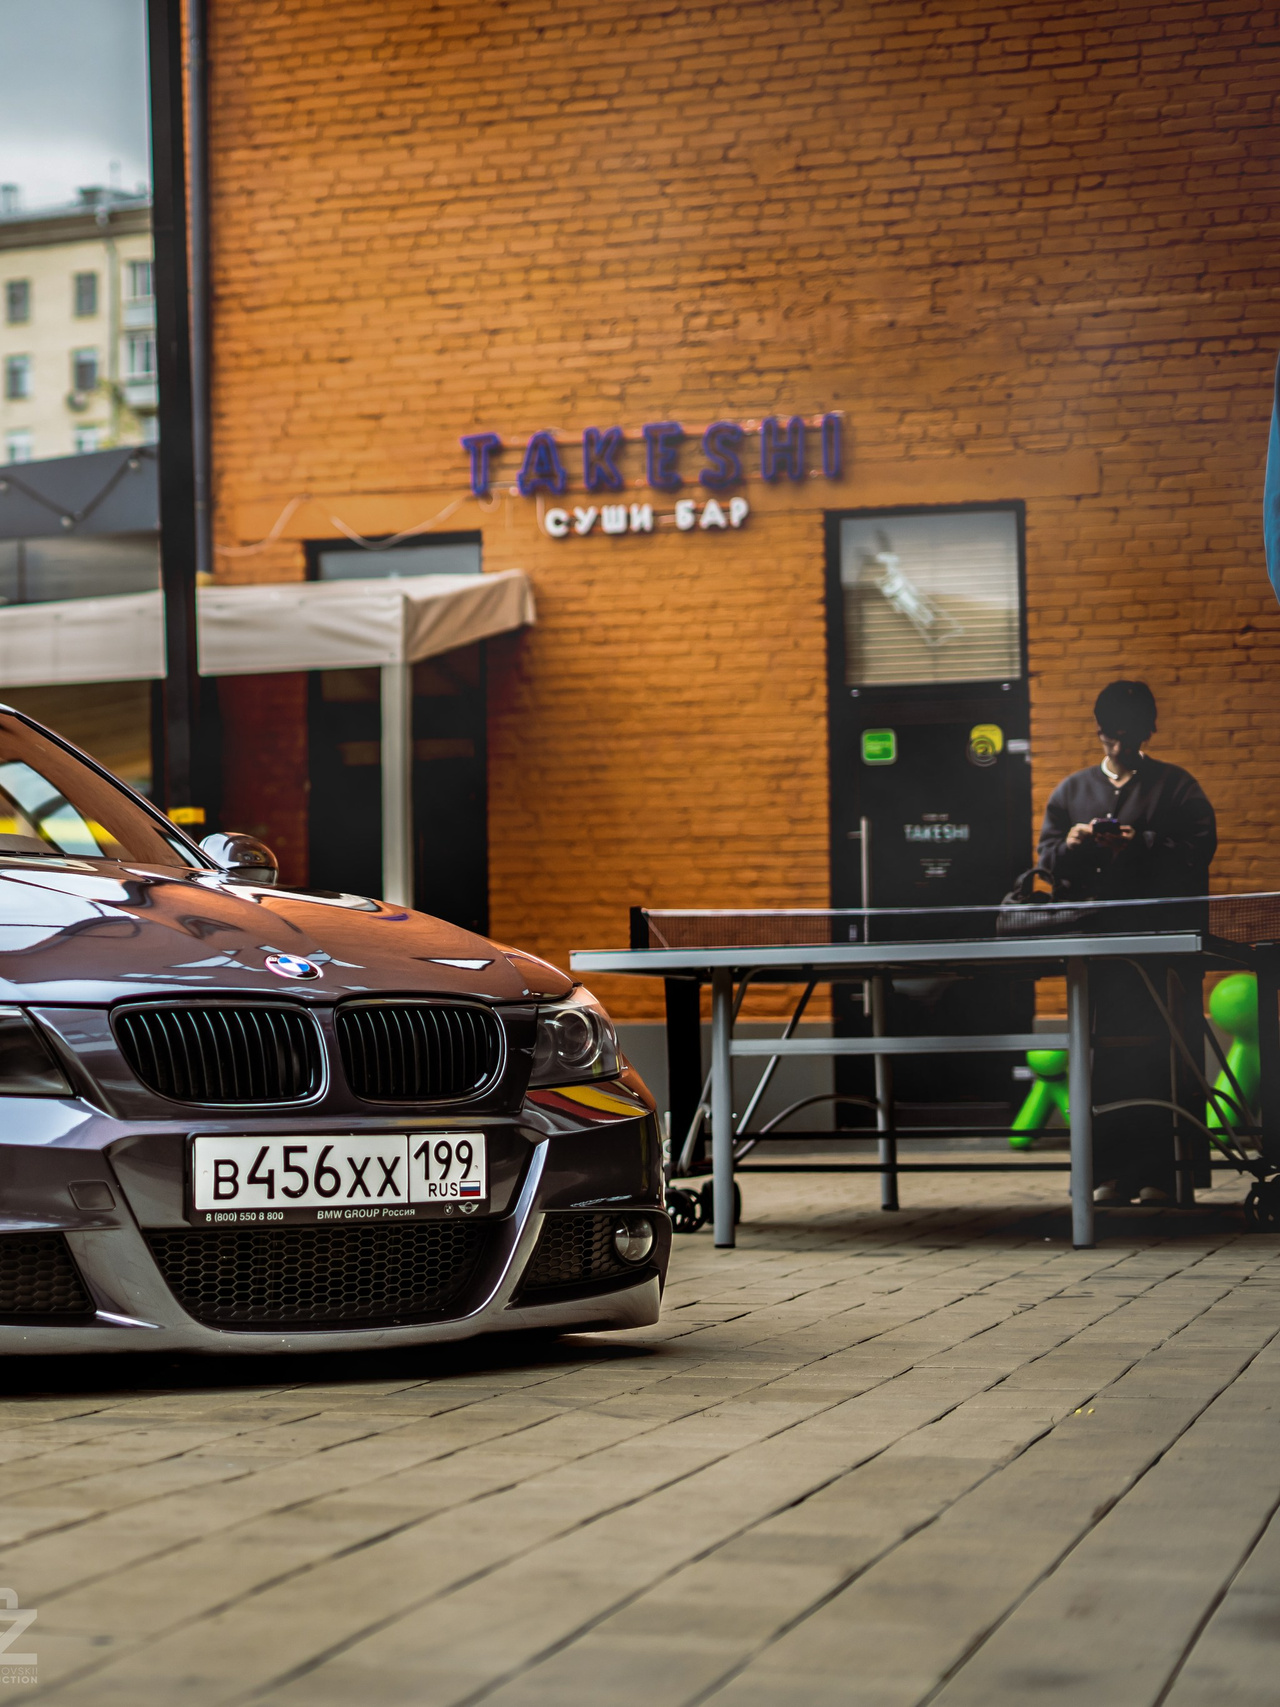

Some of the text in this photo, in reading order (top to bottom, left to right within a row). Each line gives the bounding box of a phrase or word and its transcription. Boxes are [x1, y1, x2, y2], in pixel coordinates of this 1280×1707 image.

[460, 412, 843, 496] TAKESHI
[545, 497, 750, 537] СУШИ БАР
[904, 824, 970, 843] TAKESHI
[413, 1139, 474, 1180] 199
[429, 1182, 458, 1197] RUS
[205, 1211, 284, 1222] 8 (800) 550 8 800
[317, 1208, 416, 1220] BMW GROUP Россия
